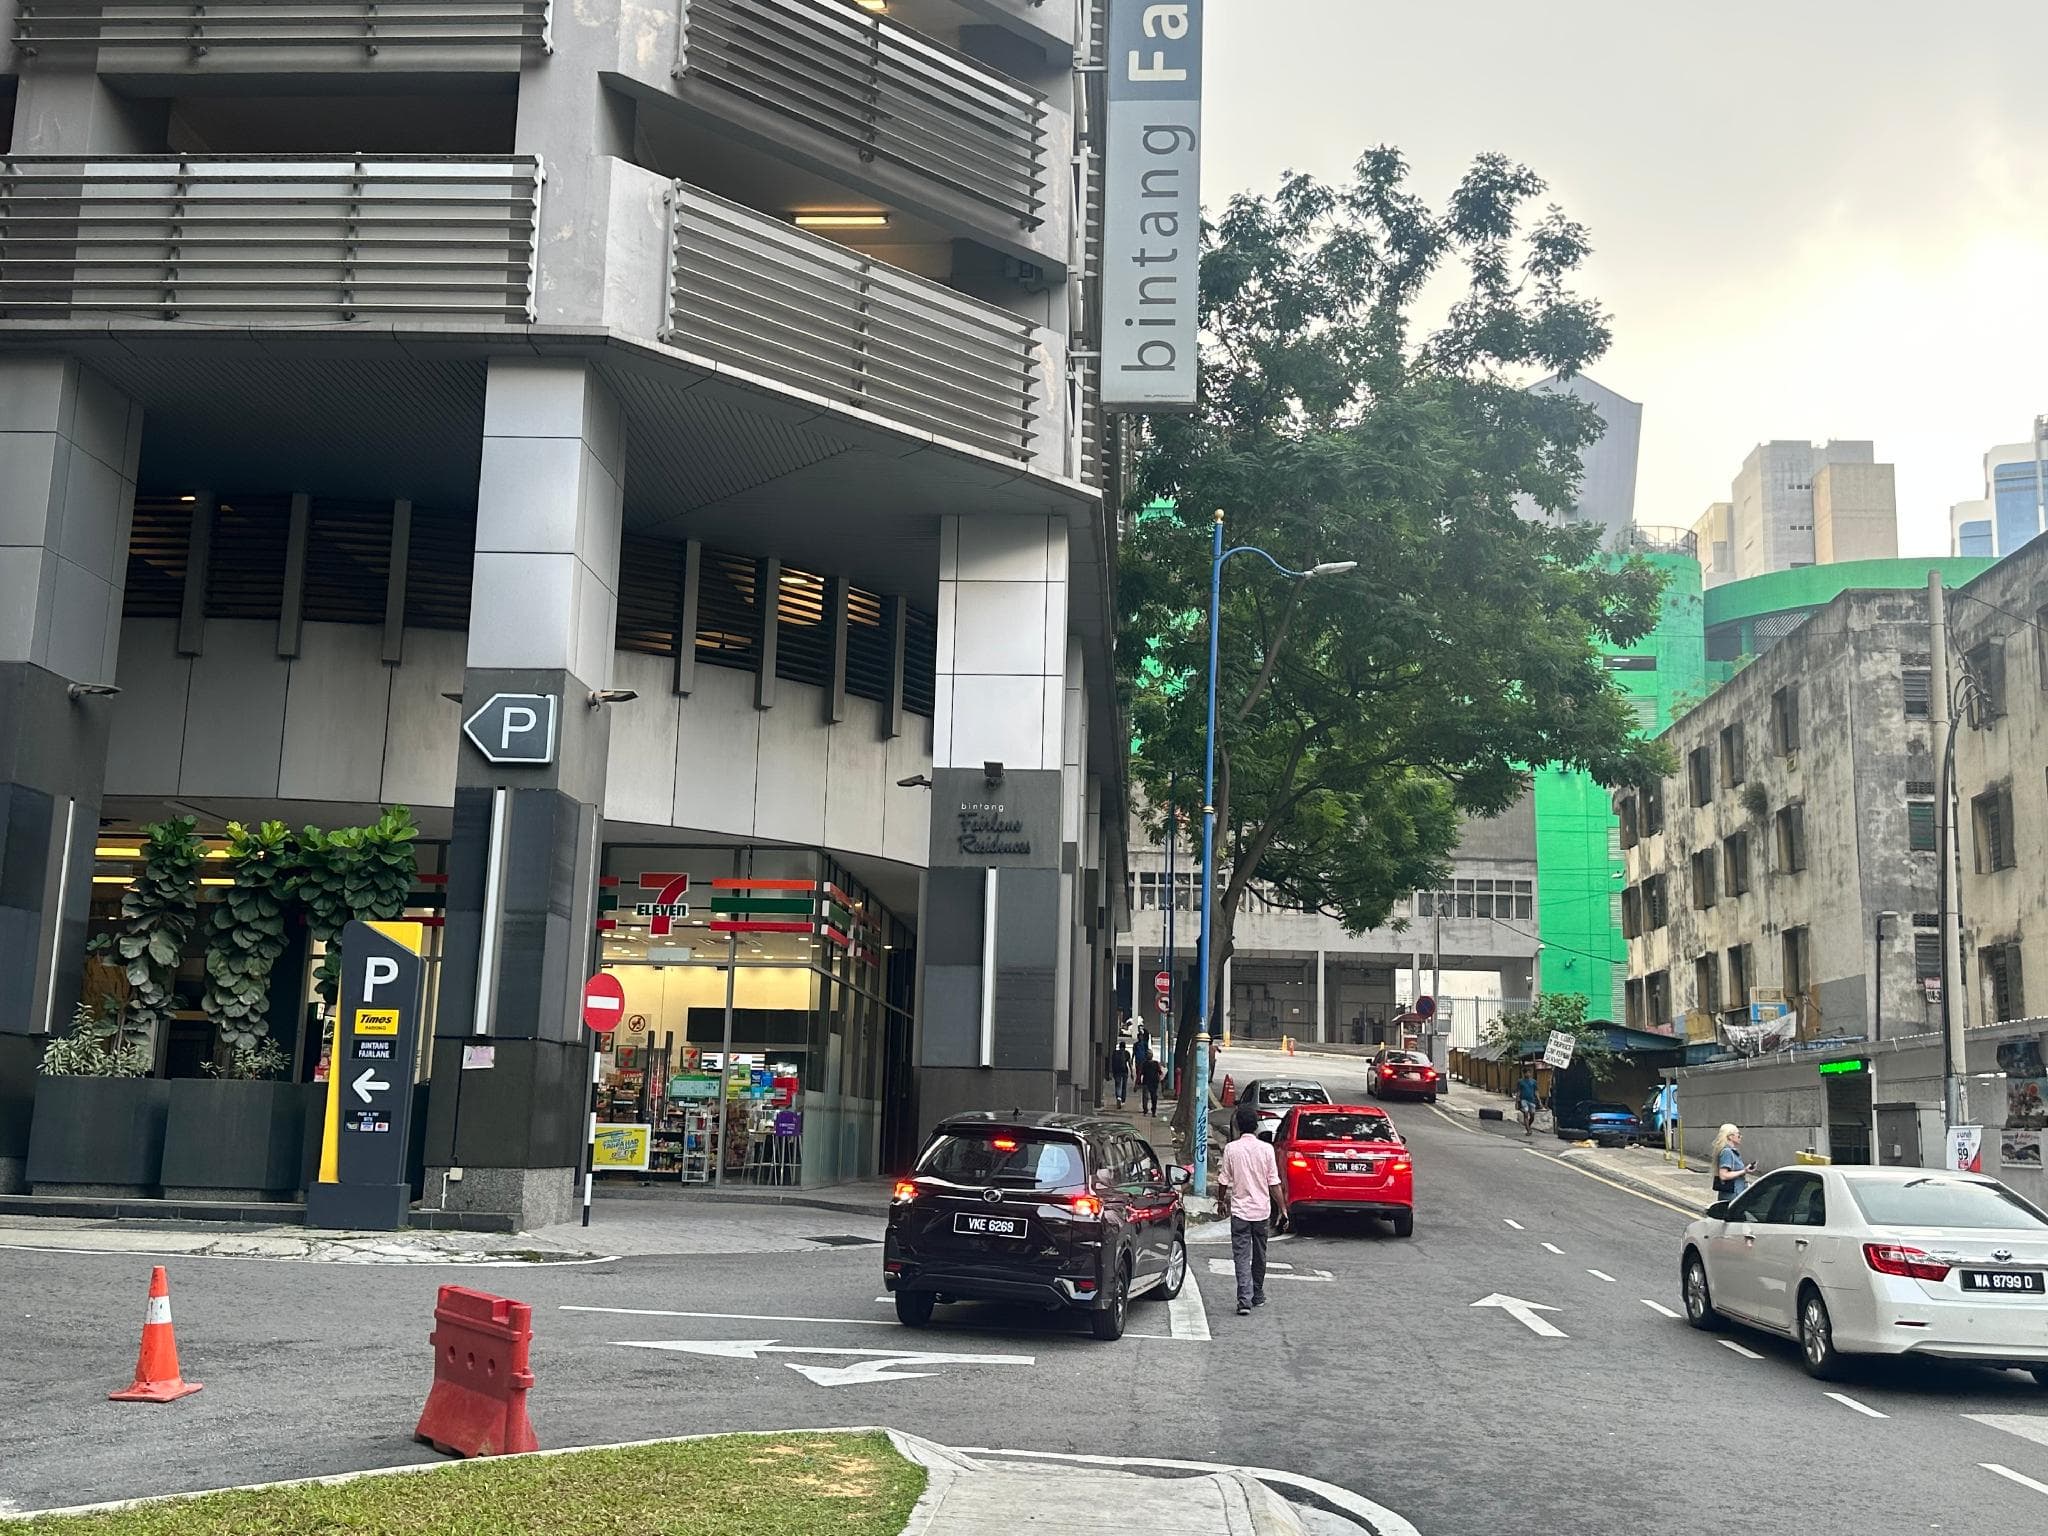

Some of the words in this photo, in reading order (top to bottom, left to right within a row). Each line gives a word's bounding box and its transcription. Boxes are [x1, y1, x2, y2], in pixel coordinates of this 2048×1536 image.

[1121, 125, 1196, 371] bintang
[502, 707, 537, 749] P
[961, 802, 1004, 813] bintang
[639, 872, 688, 937] 7
[363, 956, 399, 1003] P
[360, 1014, 393, 1024] Times
[360, 1042, 389, 1050] BINTANG
[358, 1050, 390, 1059] FAIRLANE
[968, 1217, 987, 1231] VKE
[988, 1219, 1014, 1233] 6269
[1973, 1274, 1990, 1288] WA
[1992, 1275, 2022, 1288] 8799
[2024, 1275, 2033, 1289] D
